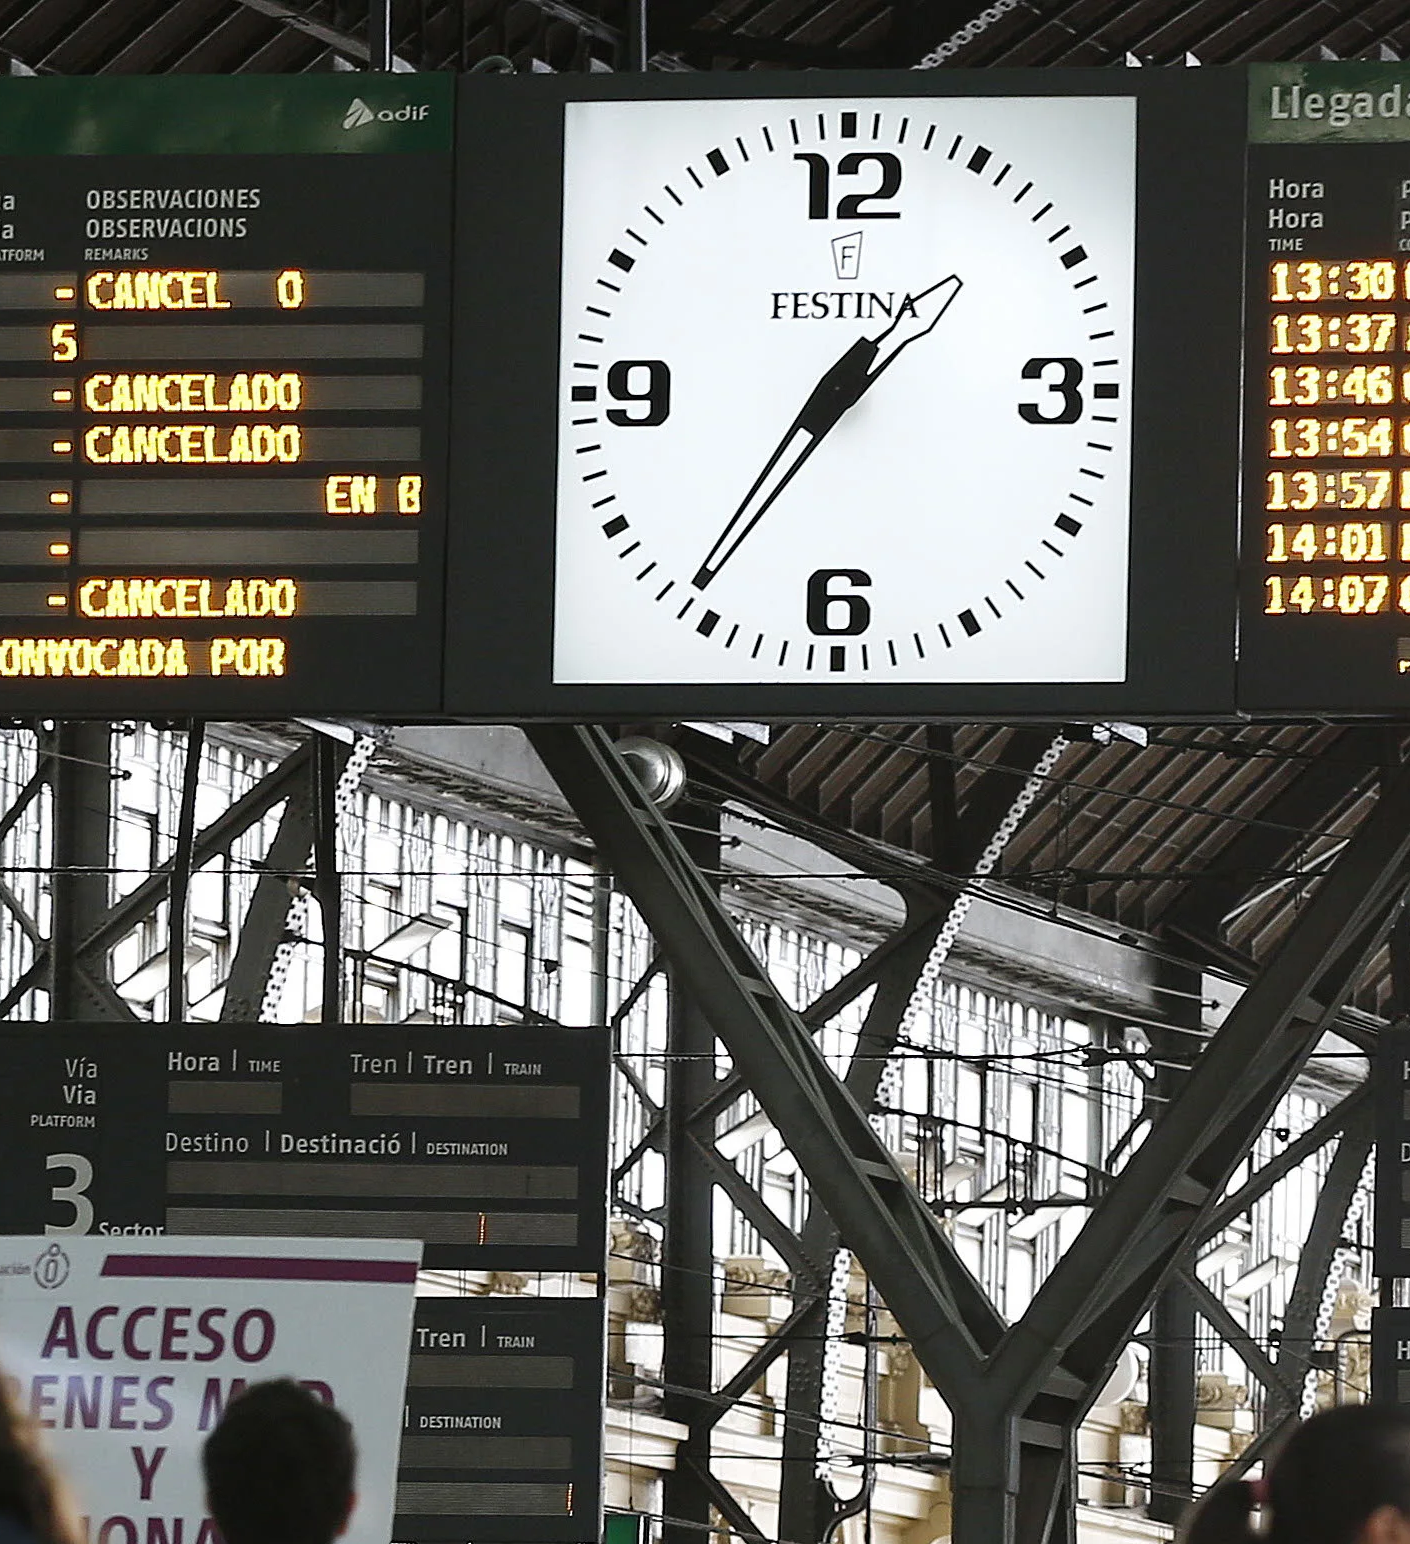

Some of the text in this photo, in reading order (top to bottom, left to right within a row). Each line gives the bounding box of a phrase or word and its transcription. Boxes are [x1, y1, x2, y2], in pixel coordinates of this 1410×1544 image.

[377, 104, 430, 122] adif
[86, 188, 261, 210] OBSERVACIONES
[793, 152, 902, 220] 12
[1269, 178, 1324, 199] Hora
[86, 217, 247, 239] OBSERVACIONS
[1268, 208, 1324, 229] Hora
[84, 247, 149, 261] REMARKS
[1268, 238, 1304, 252] TIME
[87, 271, 231, 309] CANCEL
[770, 291, 920, 320] FESTINA
[52, 324, 77, 361] 5
[1271, 313, 1396, 353] 13:37
[85, 373, 302, 412] CANCELADO
[605, 359, 671, 428] 9
[1017, 357, 1084, 425] 3
[1269, 365, 1393, 405] 13:46
[85, 425, 301, 463] CANCELADO
[1269, 418, 1393, 457] 13:54
[326, 476, 377, 514] EN
[1266, 471, 1391, 510] 13:57
[1266, 523, 1387, 562] 14:01
[80, 579, 297, 617] CANCELADO
[806, 568, 873, 637] 6
[1264, 575, 1389, 614] 14:07
[210, 638, 285, 676] POR
[65, 1056, 98, 1079] Vía
[168, 1051, 281, 1073] Hora TIME
[350, 1053, 542, 1076] Tren Tren TRAIN
[62, 1083, 96, 1105] Via
[30, 1114, 96, 1128] PLATFORM
[165, 1132, 508, 1156] Destino Destinació DESTINATION
[44, 1152, 94, 1236] 3
[41, 1305, 276, 1364] ACCESO
[416, 1328, 535, 1348] Tren TRAIN
[419, 1415, 502, 1429] DESTINATION
[130, 1445, 167, 1501] Y
